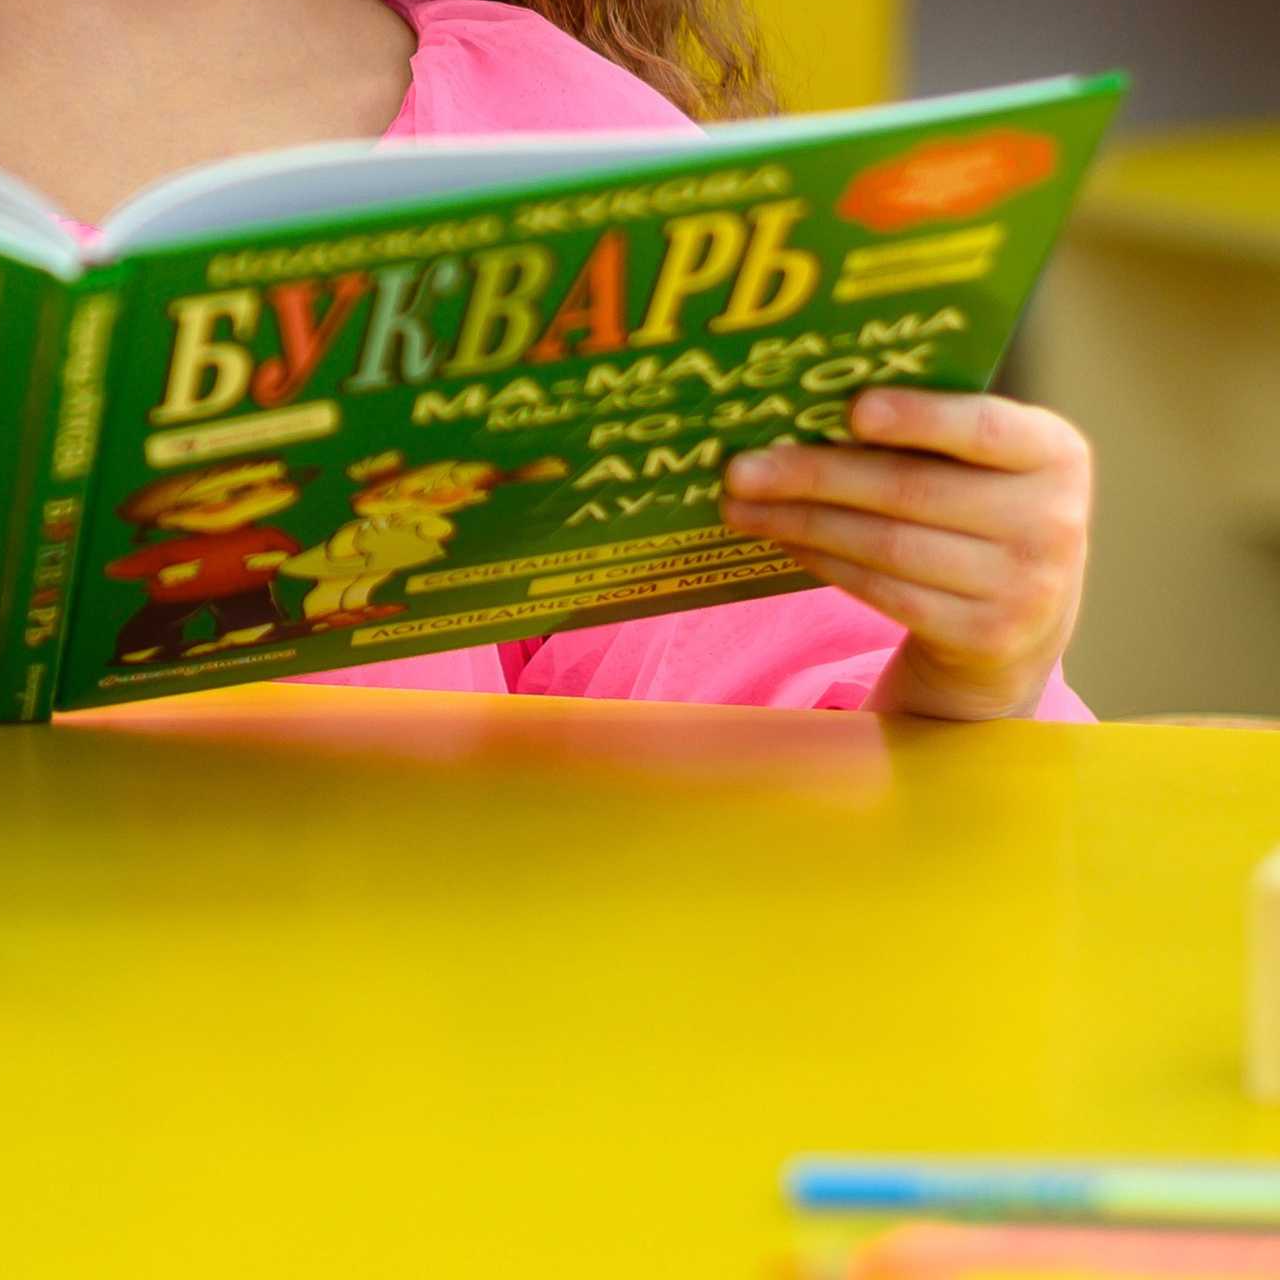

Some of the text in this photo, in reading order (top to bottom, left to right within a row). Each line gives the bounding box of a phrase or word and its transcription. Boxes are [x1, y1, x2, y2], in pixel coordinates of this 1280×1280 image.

[148, 197, 820, 426] БУКВАРЬ
[563, 482, 723, 527] ЛУ-Н
[422, 523, 735, 588] СОЧЕТАНИЕ ТРАДИЦ
